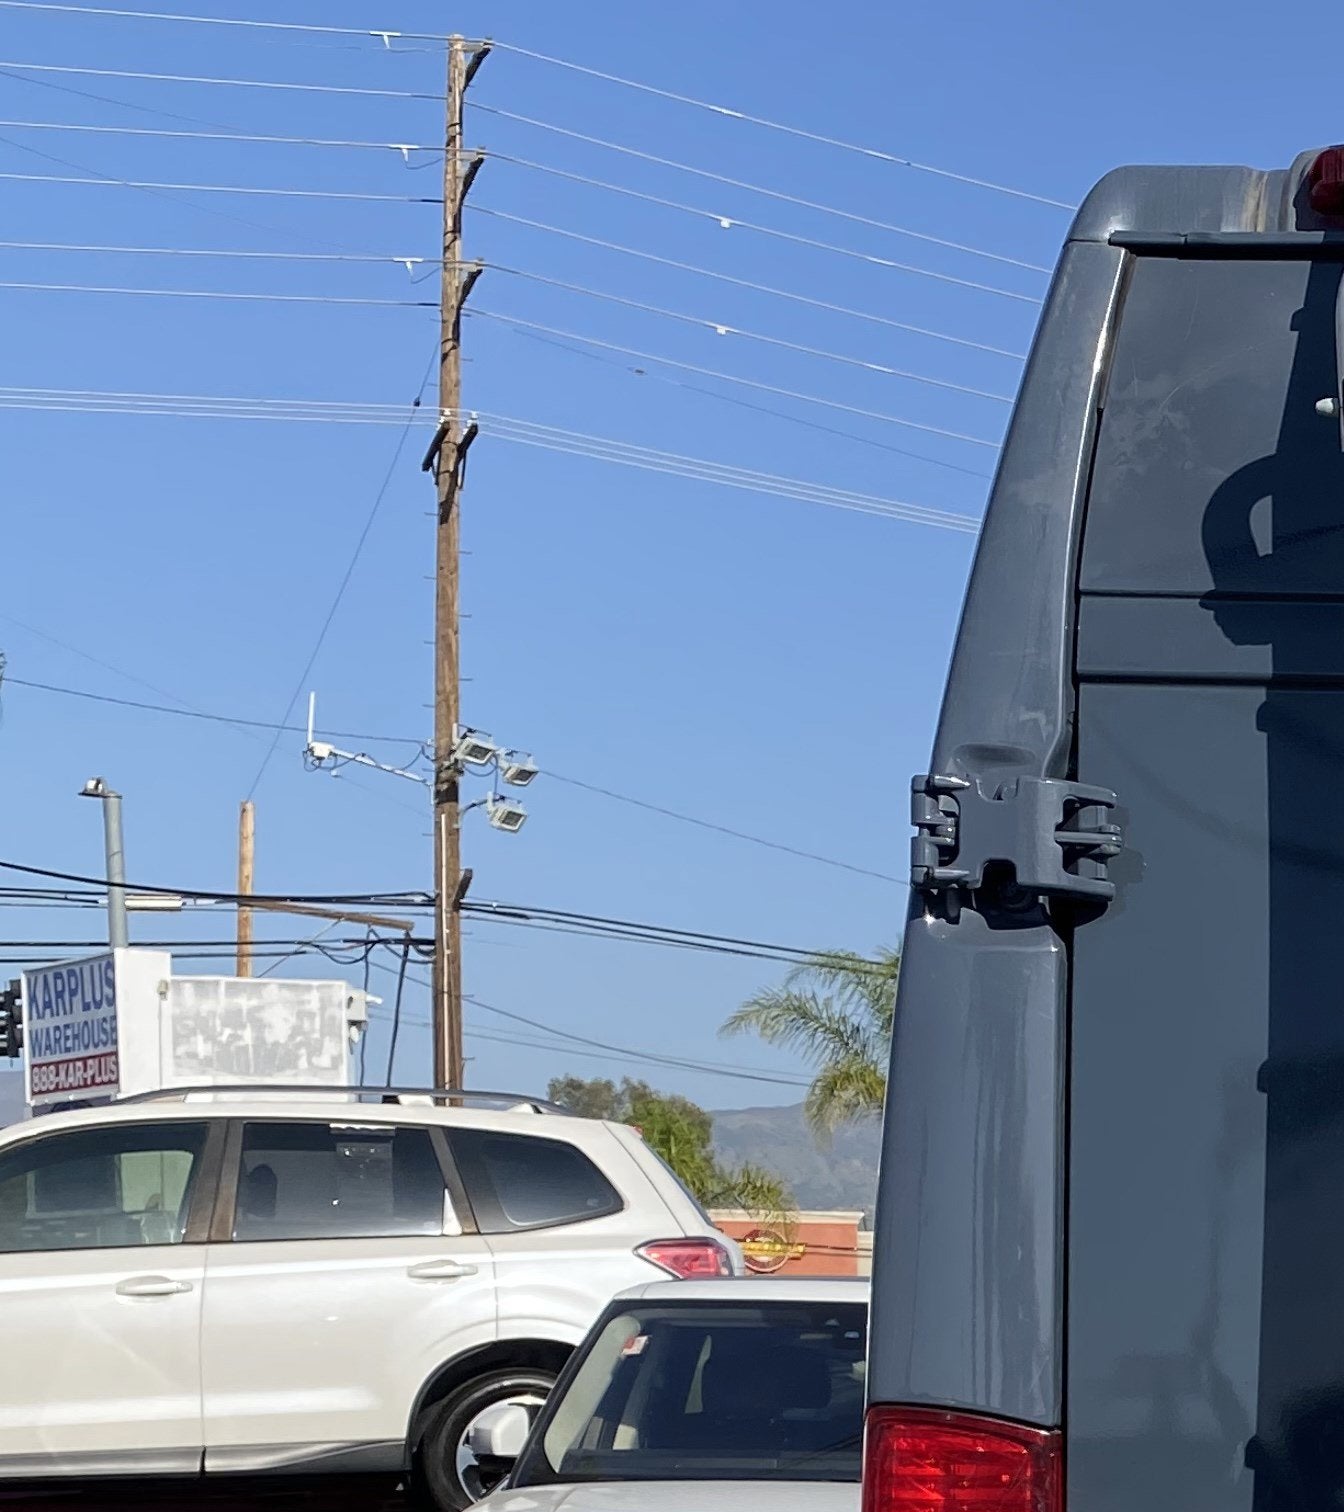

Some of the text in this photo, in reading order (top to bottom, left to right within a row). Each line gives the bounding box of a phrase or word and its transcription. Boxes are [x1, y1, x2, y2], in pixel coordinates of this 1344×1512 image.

[28, 960, 115, 1021] KARPLUS
[30, 1014, 117, 1058] WAREHOUSE
[32, 1055, 118, 1092] 888-KAR-PLUS
